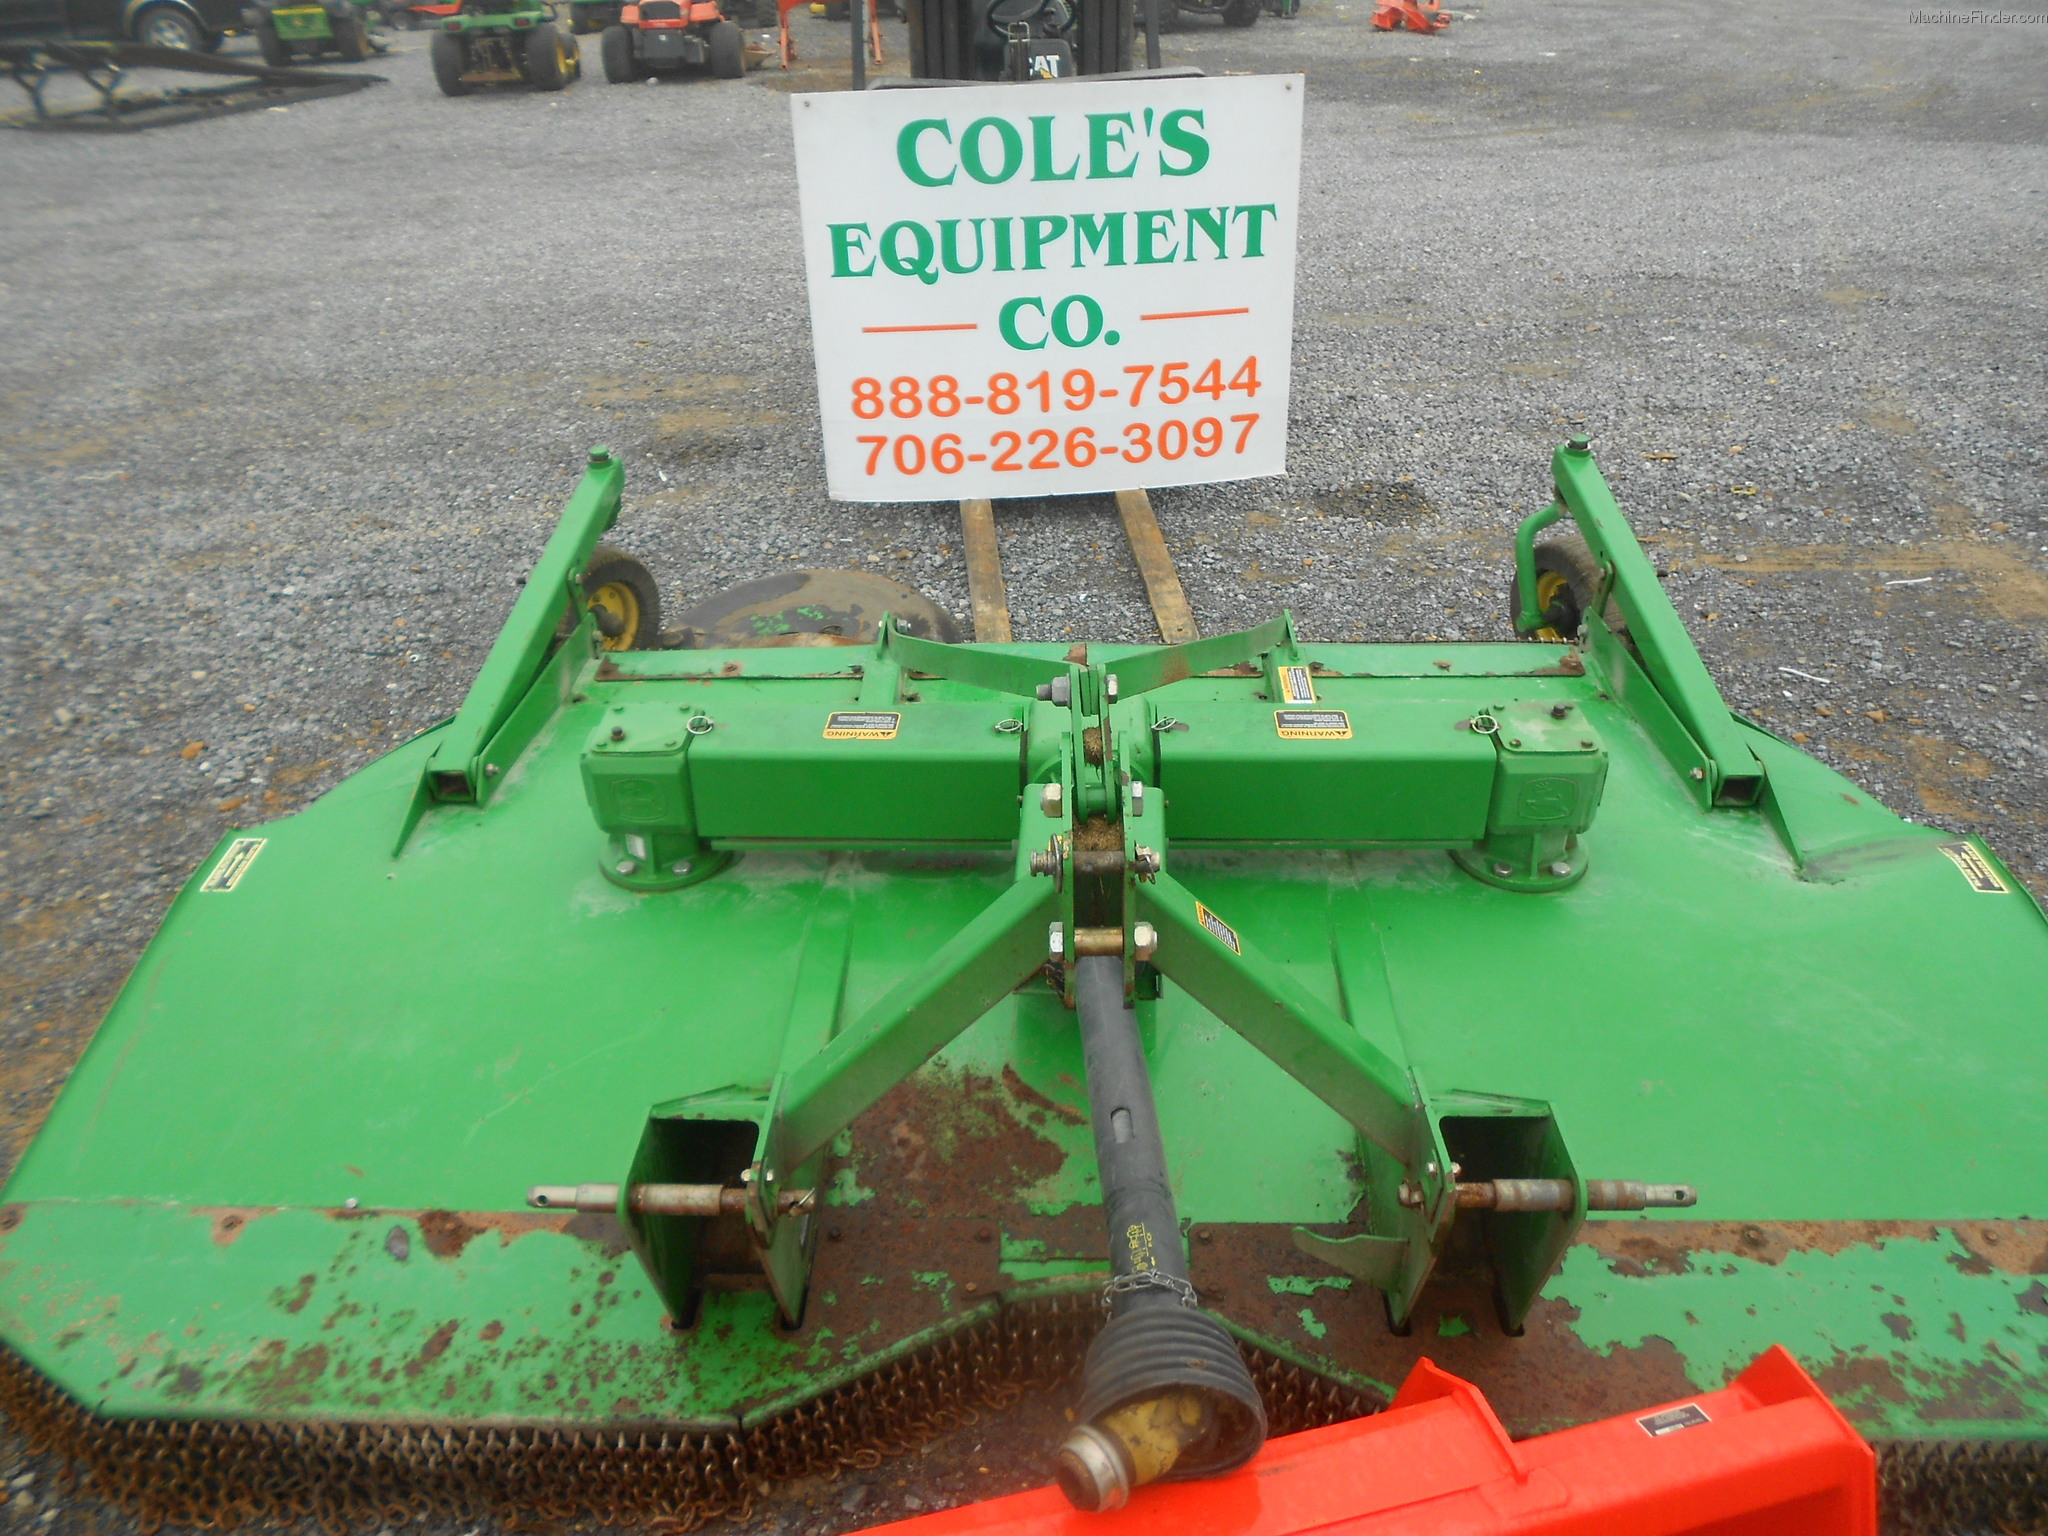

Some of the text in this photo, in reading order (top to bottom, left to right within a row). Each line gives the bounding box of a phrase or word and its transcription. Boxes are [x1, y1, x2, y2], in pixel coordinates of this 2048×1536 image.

[1028, 55, 1060, 78] AT
[896, 107, 1211, 187] COLE'S
[827, 203, 1278, 285] EQUIPMENT
[998, 294, 1122, 351] CO.
[852, 355, 1262, 419] 888-819-7544
[857, 413, 1260, 475] 706-226-3097
